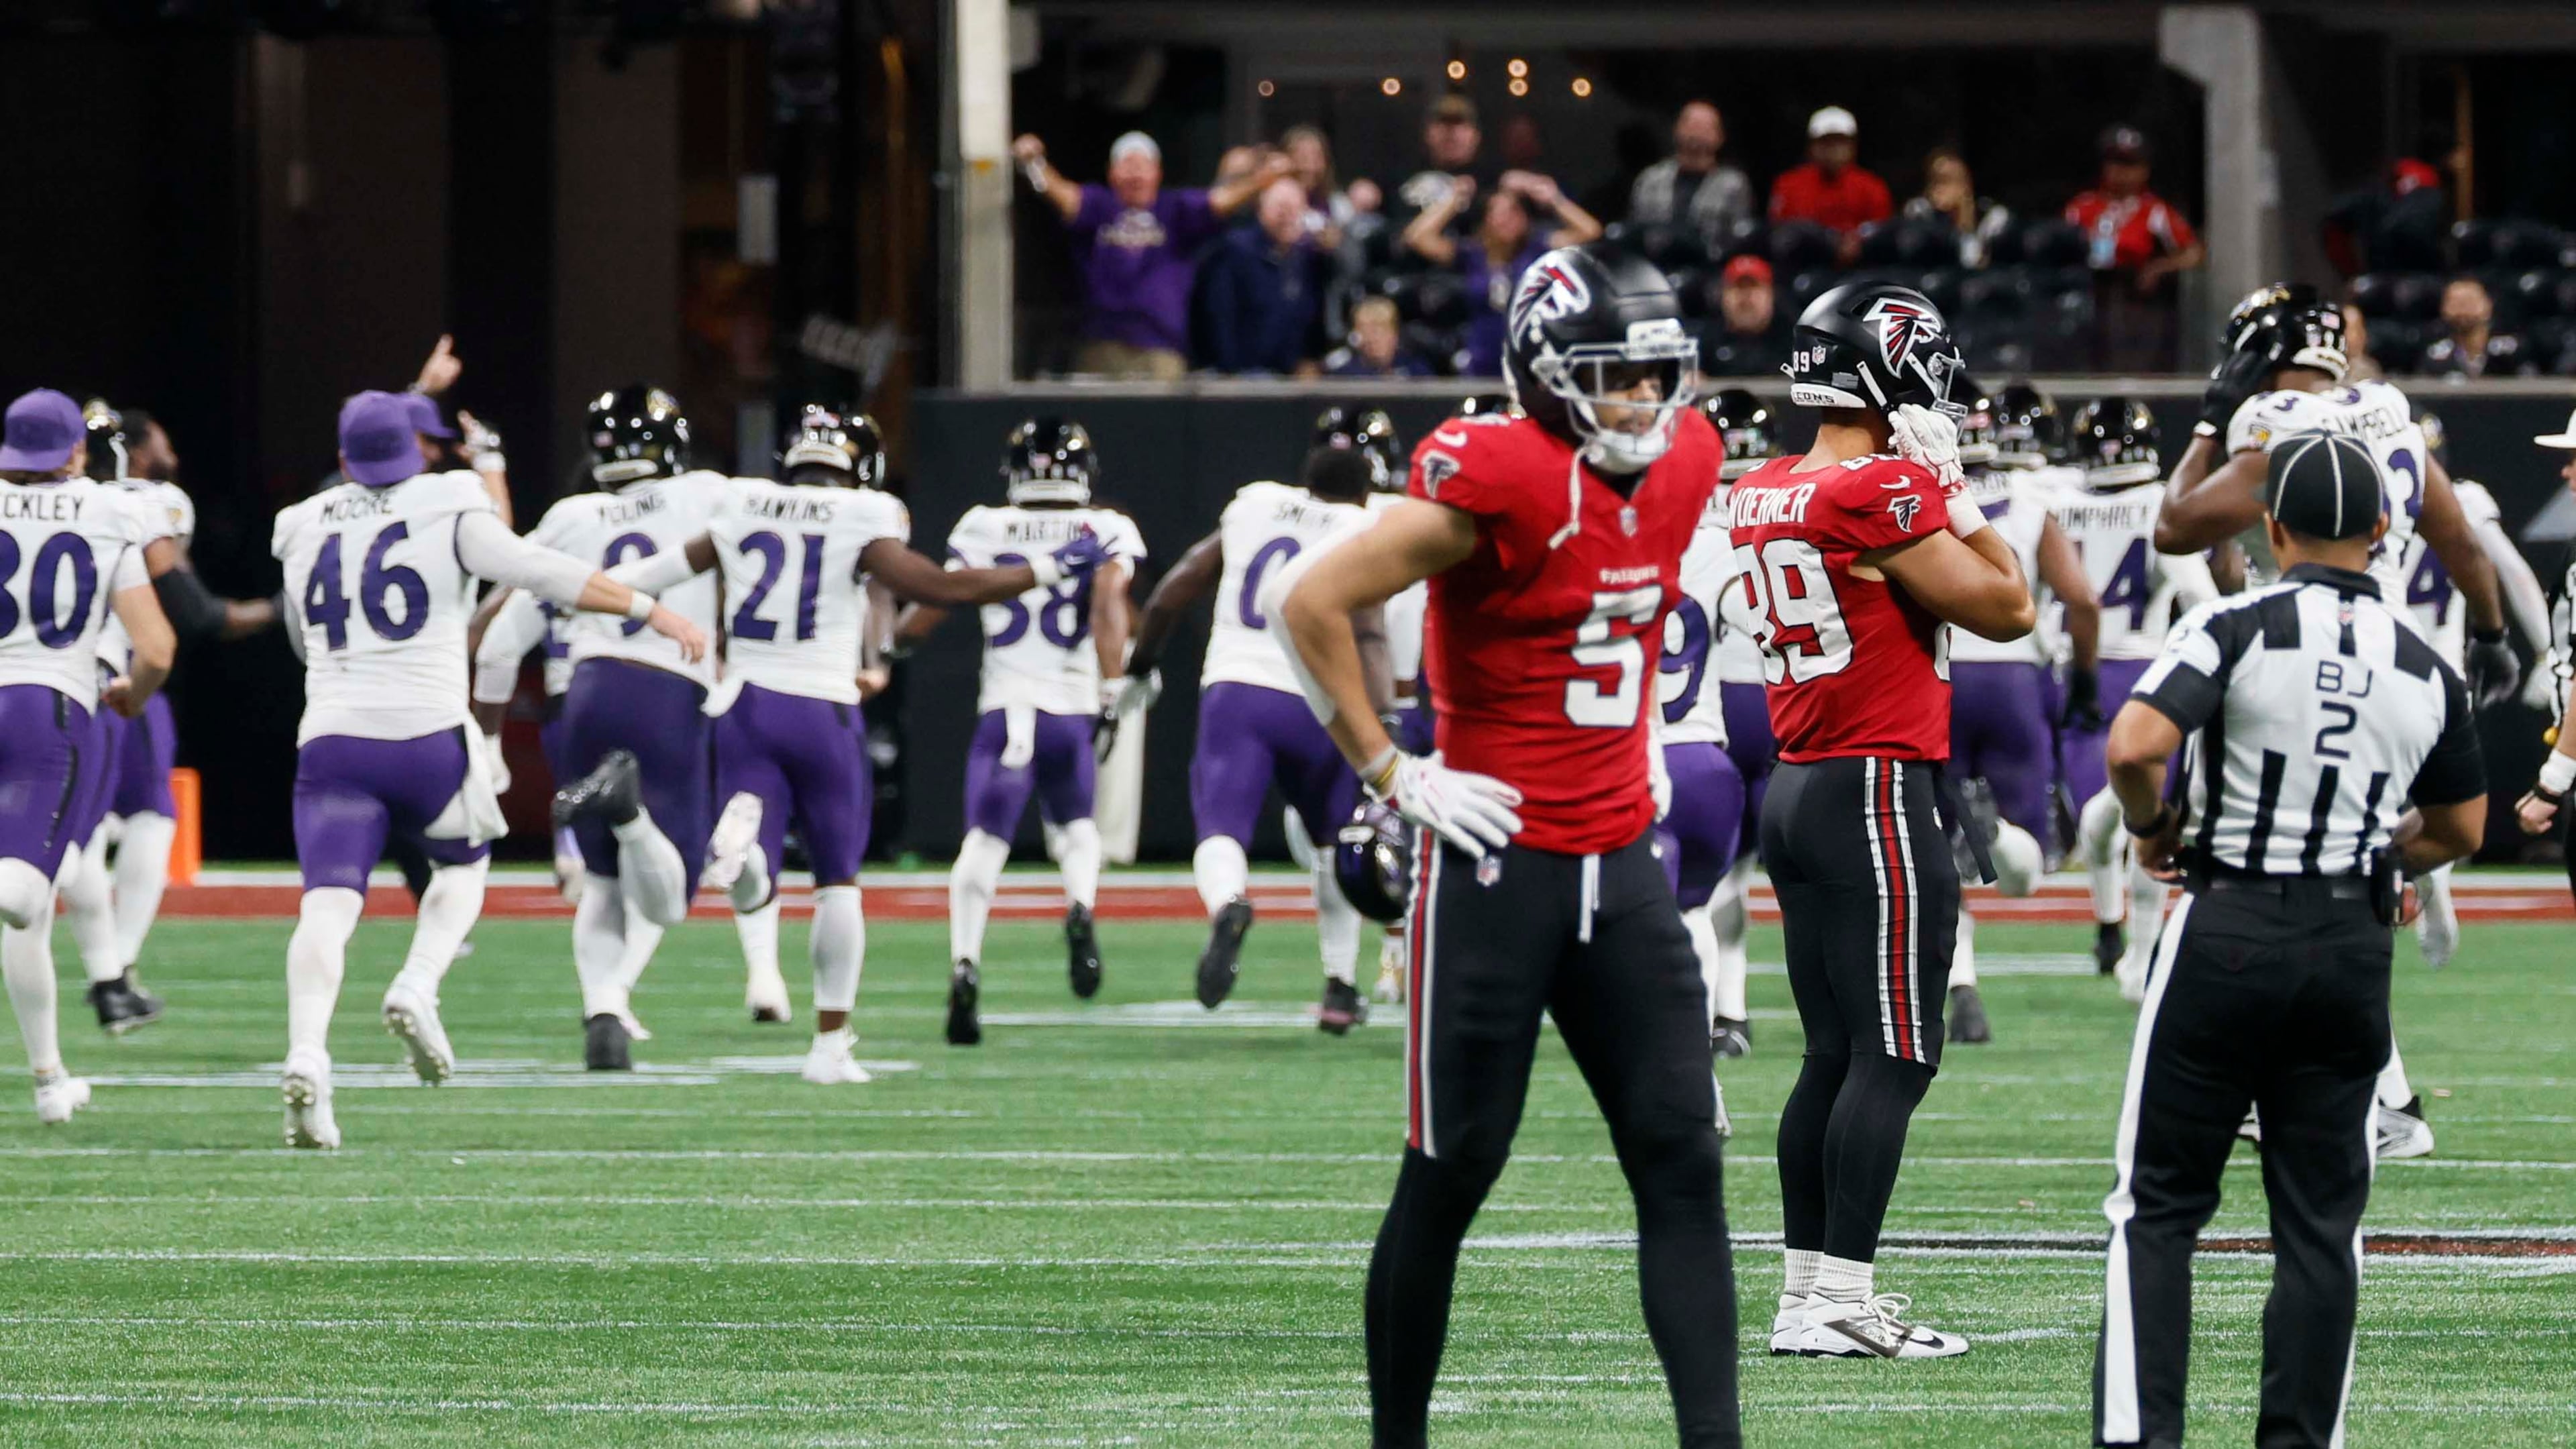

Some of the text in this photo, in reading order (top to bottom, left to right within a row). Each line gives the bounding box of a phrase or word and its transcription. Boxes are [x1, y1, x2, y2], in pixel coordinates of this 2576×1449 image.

[1793, 351, 1810, 372] 89
[743, 496, 835, 522] HAWKINS
[1729, 483, 1817, 529] WOERNER
[305, 521, 429, 651] 46
[733, 531, 826, 641] 21
[1733, 537, 1856, 685] 89
[1564, 584, 1663, 729] 5
[1658, 592, 1710, 725] 9
[2315, 660, 2373, 699] BJ
[2314, 700, 2358, 760] 2
